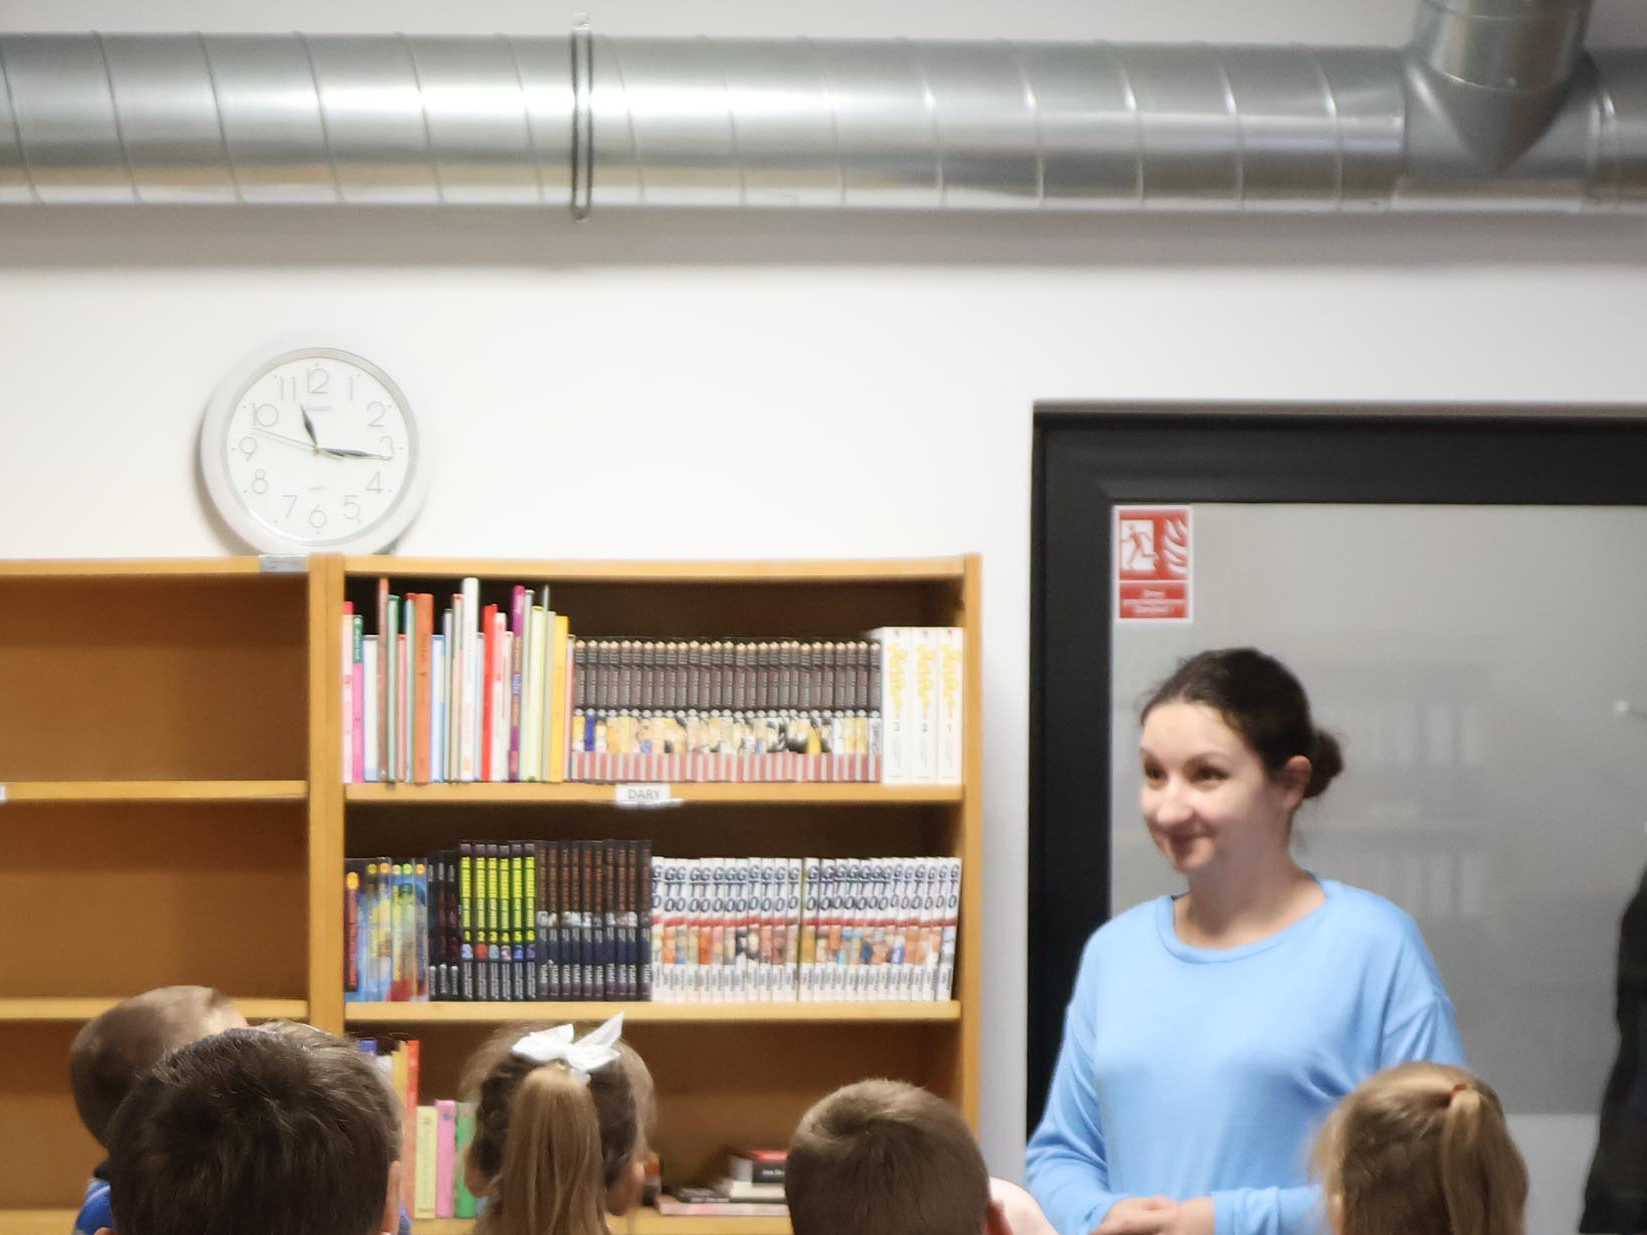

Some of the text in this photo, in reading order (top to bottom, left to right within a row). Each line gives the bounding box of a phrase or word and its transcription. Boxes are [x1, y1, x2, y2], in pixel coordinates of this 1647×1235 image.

[279, 376, 297, 401] 11
[306, 367, 330, 395] 12
[251, 403, 279, 427] 10
[366, 401, 386, 428] 2
[238, 436, 258, 462] 9
[379, 435, 394, 461] 3
[251, 468, 268, 495] 8
[365, 471, 383, 493] 4
[282, 494, 298, 519] 7
[308, 504, 328, 528] 6
[343, 495, 361, 520] 5
[627, 788, 660, 801] DARY
